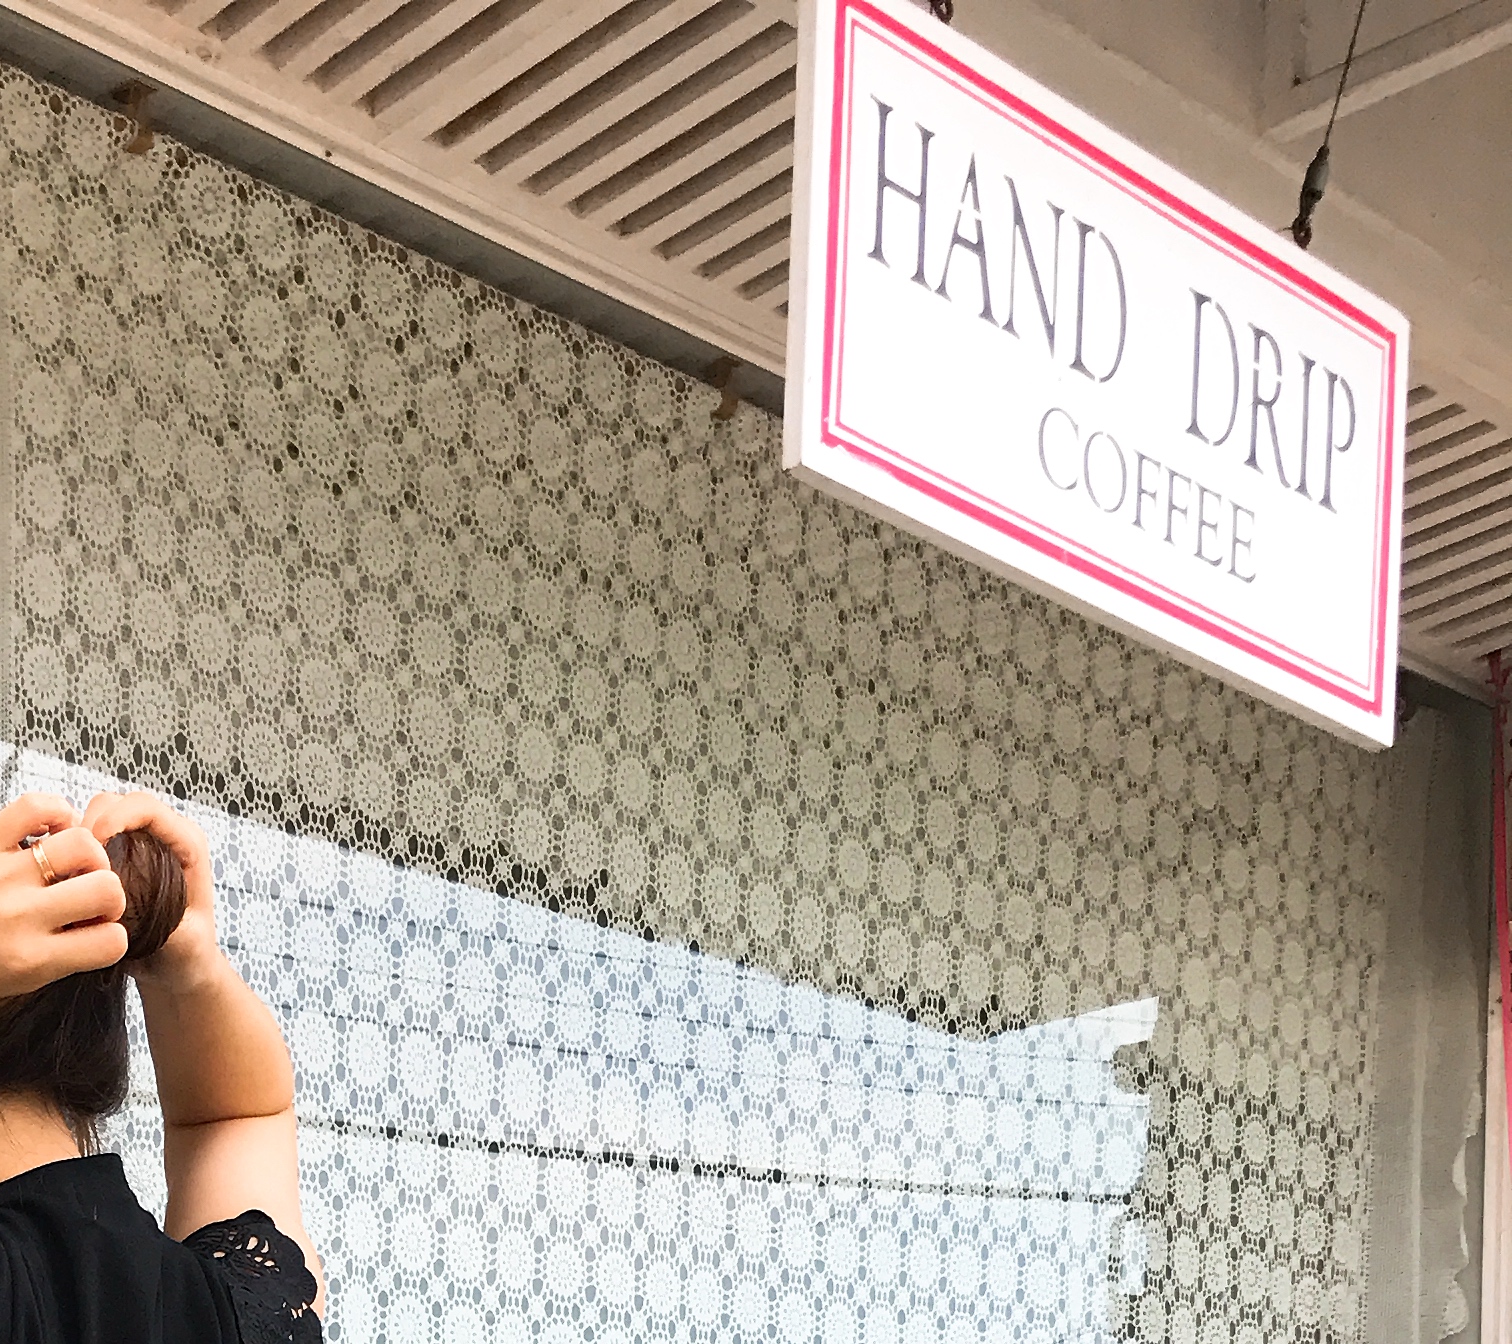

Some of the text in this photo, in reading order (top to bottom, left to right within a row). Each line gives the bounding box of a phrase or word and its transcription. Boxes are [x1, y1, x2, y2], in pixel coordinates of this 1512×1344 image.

[867, 94, 1357, 513] HAND DRIP
[1038, 406, 1258, 585] COFFEE
